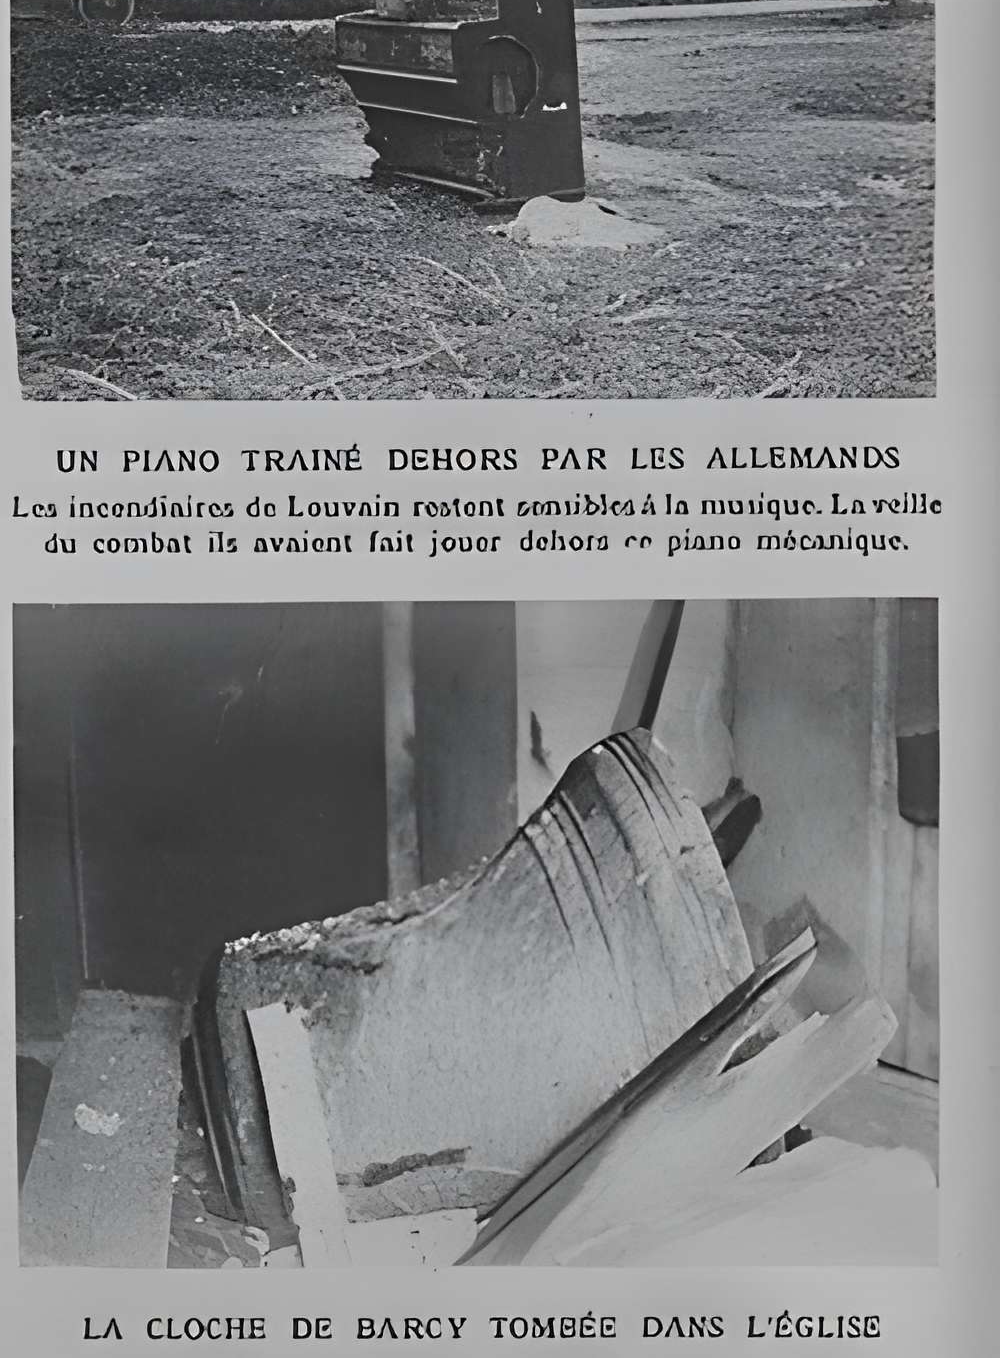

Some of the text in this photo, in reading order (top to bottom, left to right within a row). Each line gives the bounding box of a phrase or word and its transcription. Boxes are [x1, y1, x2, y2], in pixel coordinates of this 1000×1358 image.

[56, 442, 901, 474] UN PIANO TRAINÉ DEHORS PAR LES ALLEMANDS
[82, 1308, 881, 1341] LA CLOCHE DE BARCY TOMBÉE DANS L'ÉGLISE
